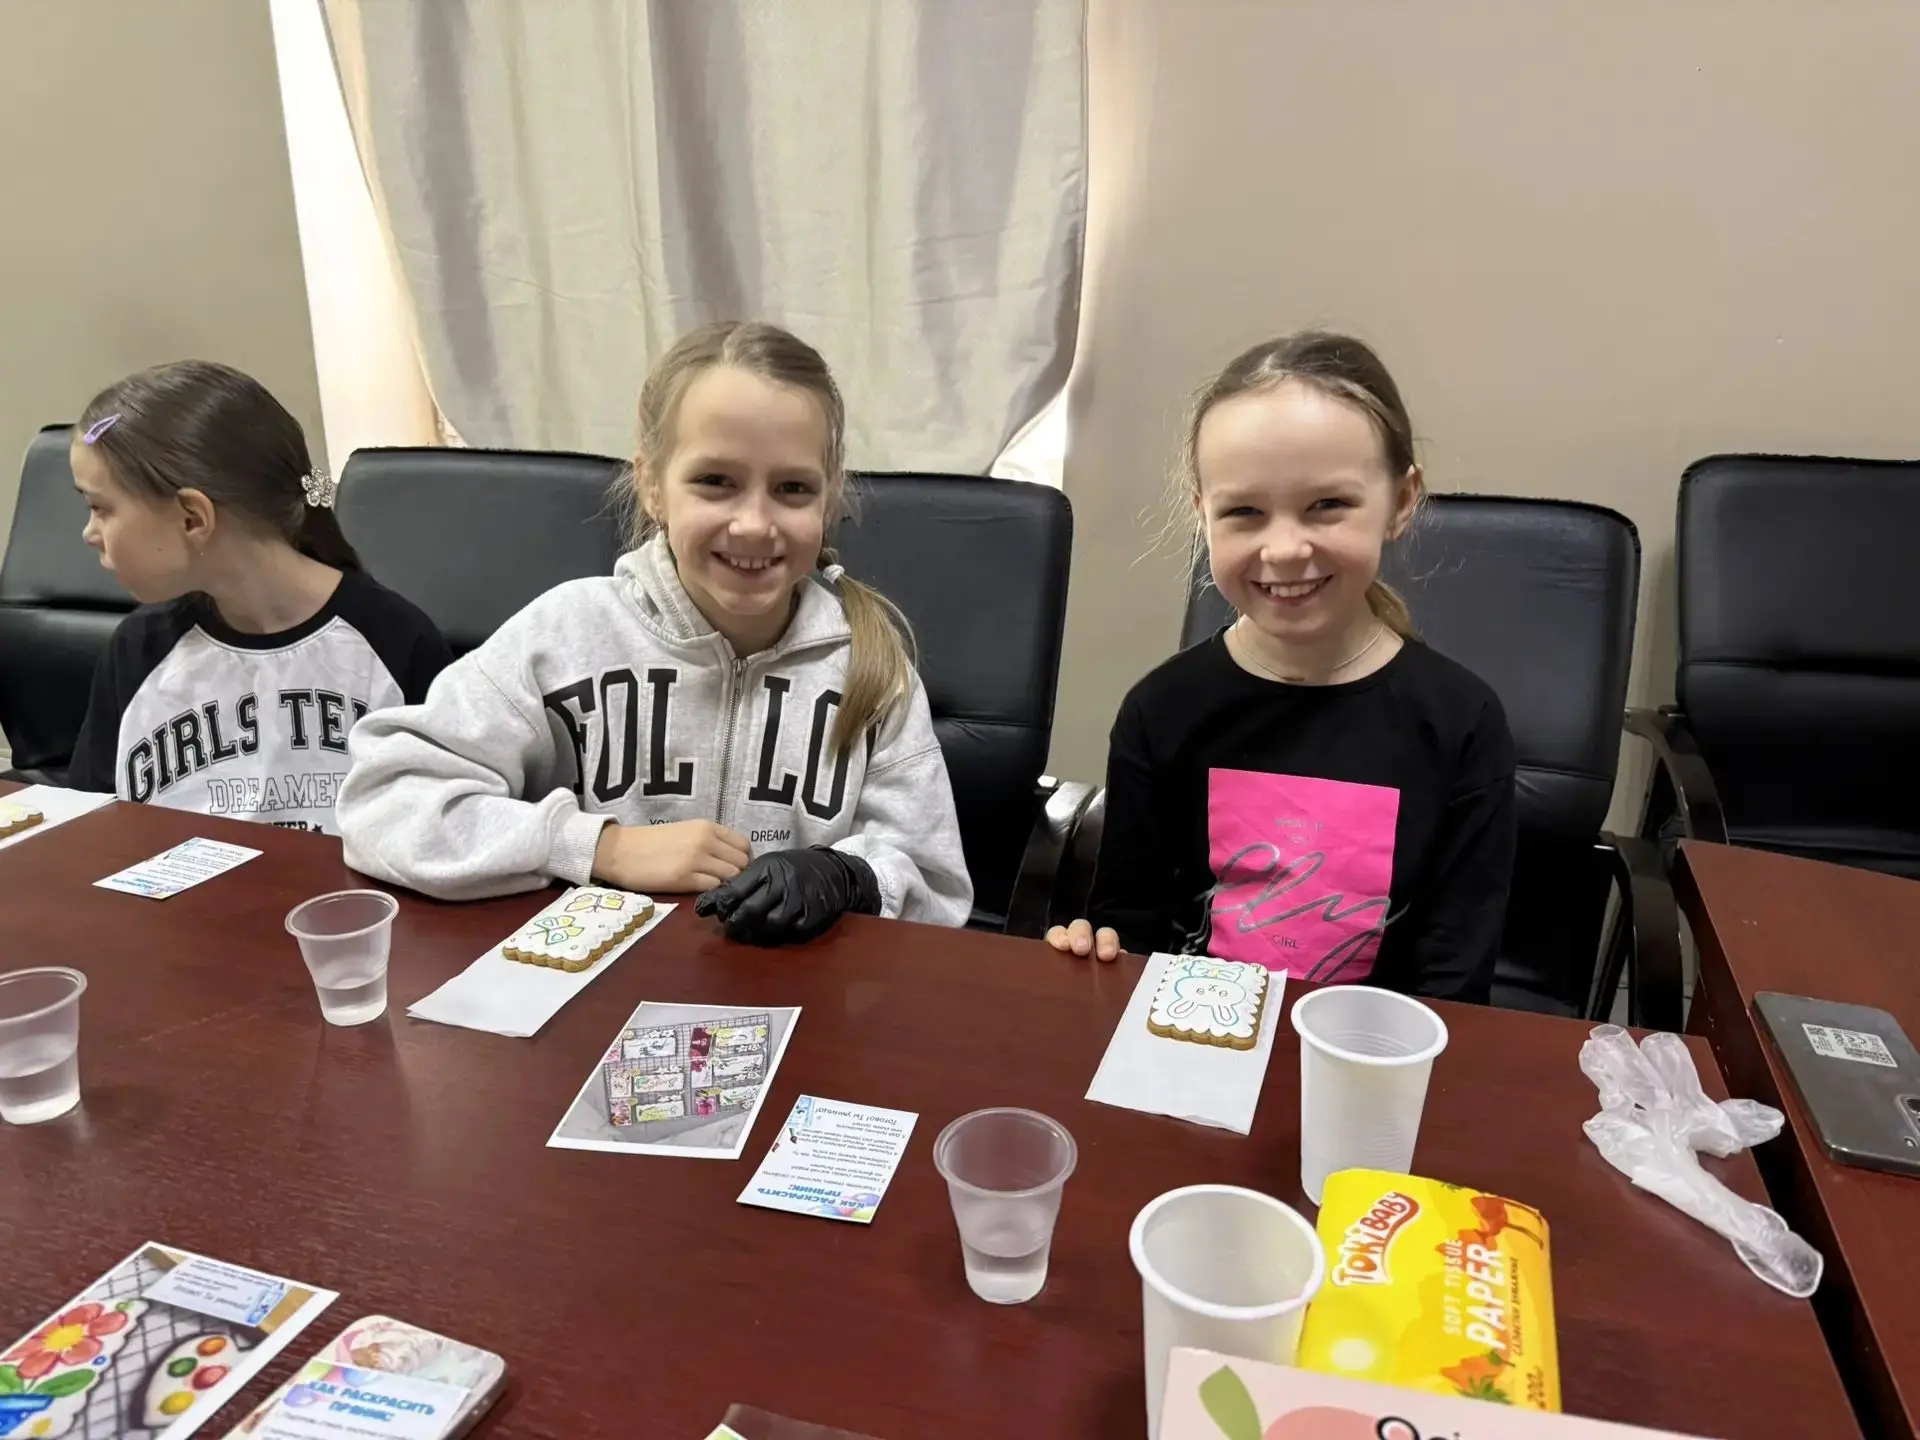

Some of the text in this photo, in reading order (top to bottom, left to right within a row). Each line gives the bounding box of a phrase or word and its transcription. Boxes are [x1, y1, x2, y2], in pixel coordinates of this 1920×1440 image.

[125, 692, 260, 804] GIRLS
[749, 675, 878, 821] LO
[751, 830, 790, 842] DREAM
[1272, 933, 1300, 949] GIRL
[839, 1198, 865, 1209] КАК
[1443, 1239, 1463, 1335] SOFT TISSUE
[1465, 1243, 1507, 1350] PAPER
